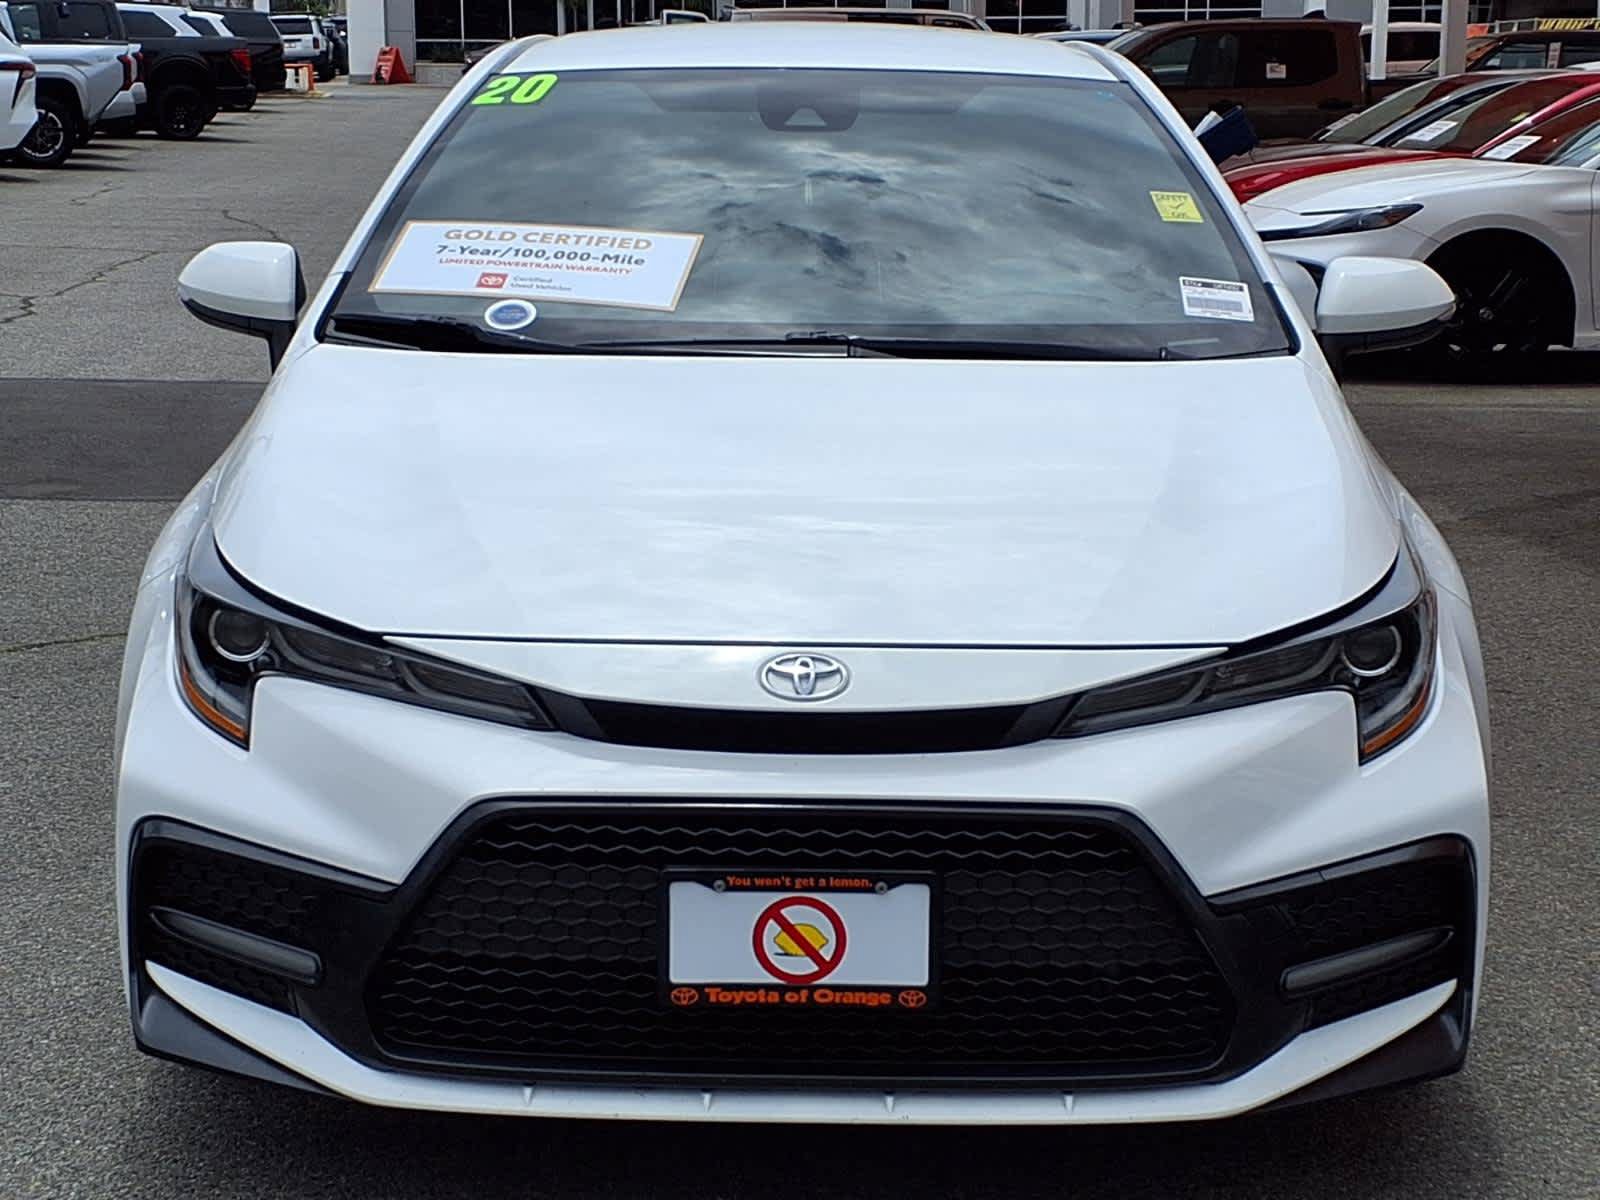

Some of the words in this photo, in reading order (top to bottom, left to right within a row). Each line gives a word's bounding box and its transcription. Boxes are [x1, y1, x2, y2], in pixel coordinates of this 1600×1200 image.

[471, 73, 558, 105] 20
[444, 229, 517, 241] GOLD
[522, 232, 652, 250] CERTIFIED
[436, 244, 646, 266] 7-Year/100,000-Mile
[439, 257, 485, 266] LIMITED
[486, 259, 563, 270] POWERTRAIN
[566, 263, 632, 275] WARRANTY
[726, 875, 751, 887] You
[754, 876, 792, 888] won't
[794, 877, 815, 889] get
[817, 878, 827, 888] a
[829, 876, 873, 889] lemon.
[704, 987, 780, 1004] Toyota
[784, 988, 808, 1004] of
[813, 988, 892, 1006] Orange
